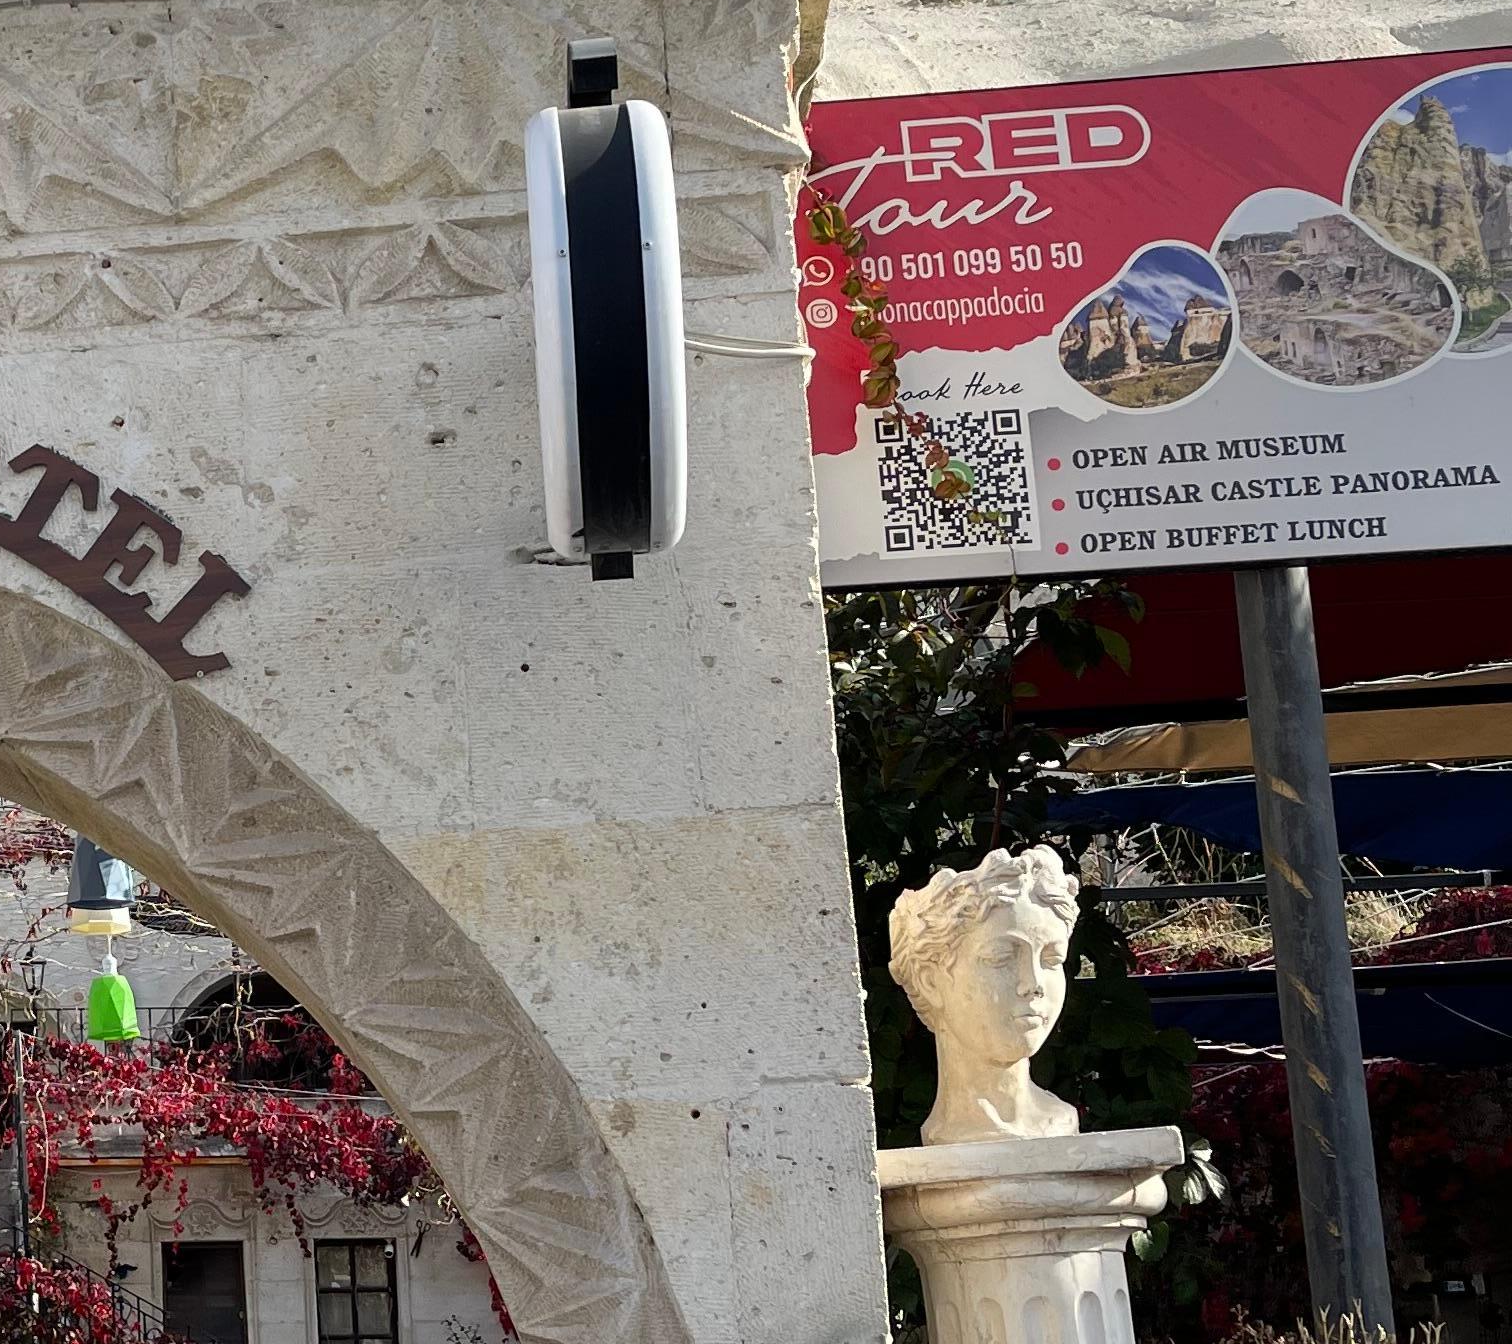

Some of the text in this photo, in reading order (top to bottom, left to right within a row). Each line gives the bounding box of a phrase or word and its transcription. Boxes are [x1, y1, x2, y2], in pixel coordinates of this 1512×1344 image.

[899, 104, 1152, 183] RED
[805, 146, 1053, 236] Tour
[901, 251, 945, 281] 501
[953, 247, 1002, 277] 099
[1009, 244, 1043, 273] 50
[1050, 241, 1083, 270] 50
[877, 286, 1044, 325] onacappadocia
[897, 371, 1024, 401] ook Here
[1072, 433, 1347, 469] OPEN AIR MUSEUM
[1076, 464, 1501, 514] UÇHISAR CASTLE PANORAMA
[1080, 515, 1387, 554] OPEN BUFFET LUNCH
